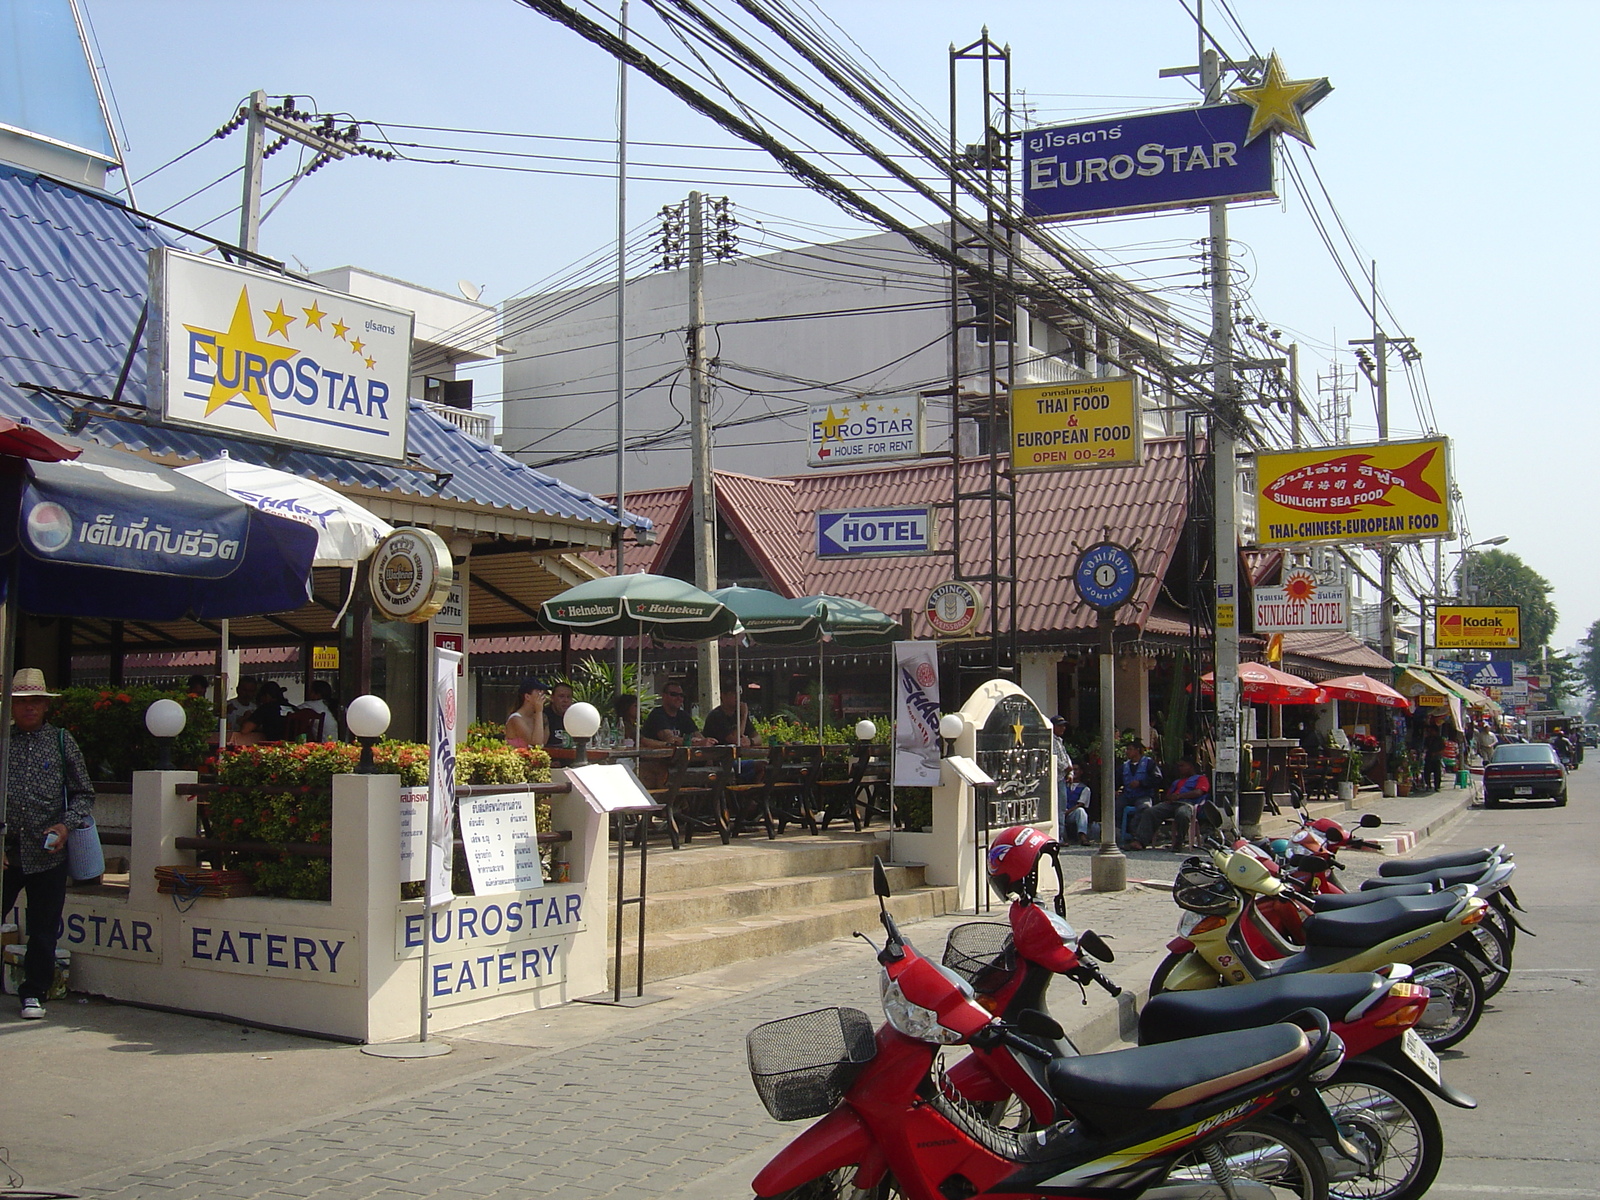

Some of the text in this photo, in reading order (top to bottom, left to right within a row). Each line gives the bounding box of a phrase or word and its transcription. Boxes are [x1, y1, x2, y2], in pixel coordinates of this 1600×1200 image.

[1030, 124, 1122, 152] ยูโรสตาร์
[365, 320, 395, 335] ยูโรสตาร์
[1037, 395, 1110, 414] THAI FOOD
[1067, 414, 1078, 427] &
[1017, 425, 1131, 447] EUROPEAN FOOD
[834, 440, 913, 456] HOUSE FOR RENT
[1033, 451, 1067, 463] OPEN
[1274, 489, 1384, 508] SUNLIGHT SEA FOOD
[229, 488, 340, 530] SHARK
[843, 521, 924, 542] HOTEL
[1269, 514, 1439, 539] THAI-CHINESE-EUROPEAN FOOD
[78, 514, 239, 560] เต็มที่กับชีวิต
[1083, 549, 1129, 576] จอมเทียน
[1103, 570, 1108, 582] 1
[410, 582, 421, 597] DEN
[930, 585, 972, 605] ERDINGER
[1086, 587, 1124, 600] JOMTIEN
[568, 604, 615, 617] Heineken
[648, 603, 704, 616] Heineken
[1257, 604, 1305, 626] SUNLIGHT
[1310, 602, 1343, 625] HOTEL
[1463, 617, 1503, 627] Kodak
[1493, 628, 1515, 636] FILM
[442, 640, 456, 650] ICE
[1473, 677, 1503, 685] adidas
[405, 894, 582, 948] EUROSTAR
[191, 926, 345, 973] EATERY
[433, 944, 559, 997] EATERY
